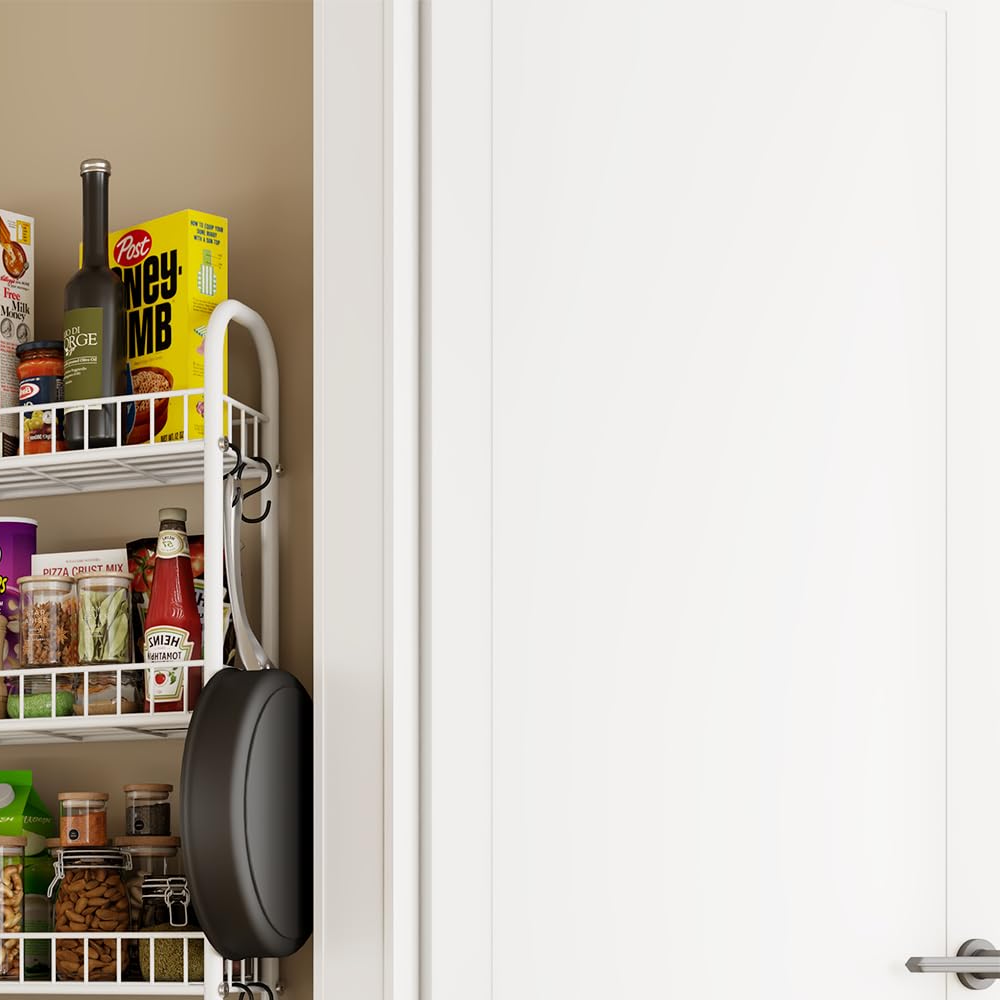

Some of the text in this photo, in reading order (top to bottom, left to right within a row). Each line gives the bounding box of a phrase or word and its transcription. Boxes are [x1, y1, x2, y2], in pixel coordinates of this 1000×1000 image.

[116, 235, 150, 263] Post
[3, 287, 21, 300] Free
[0, 305, 25, 322] Money
[12, 300, 30, 314] Milk
[43, 563, 123, 577] PIZZA CRUST MIX
